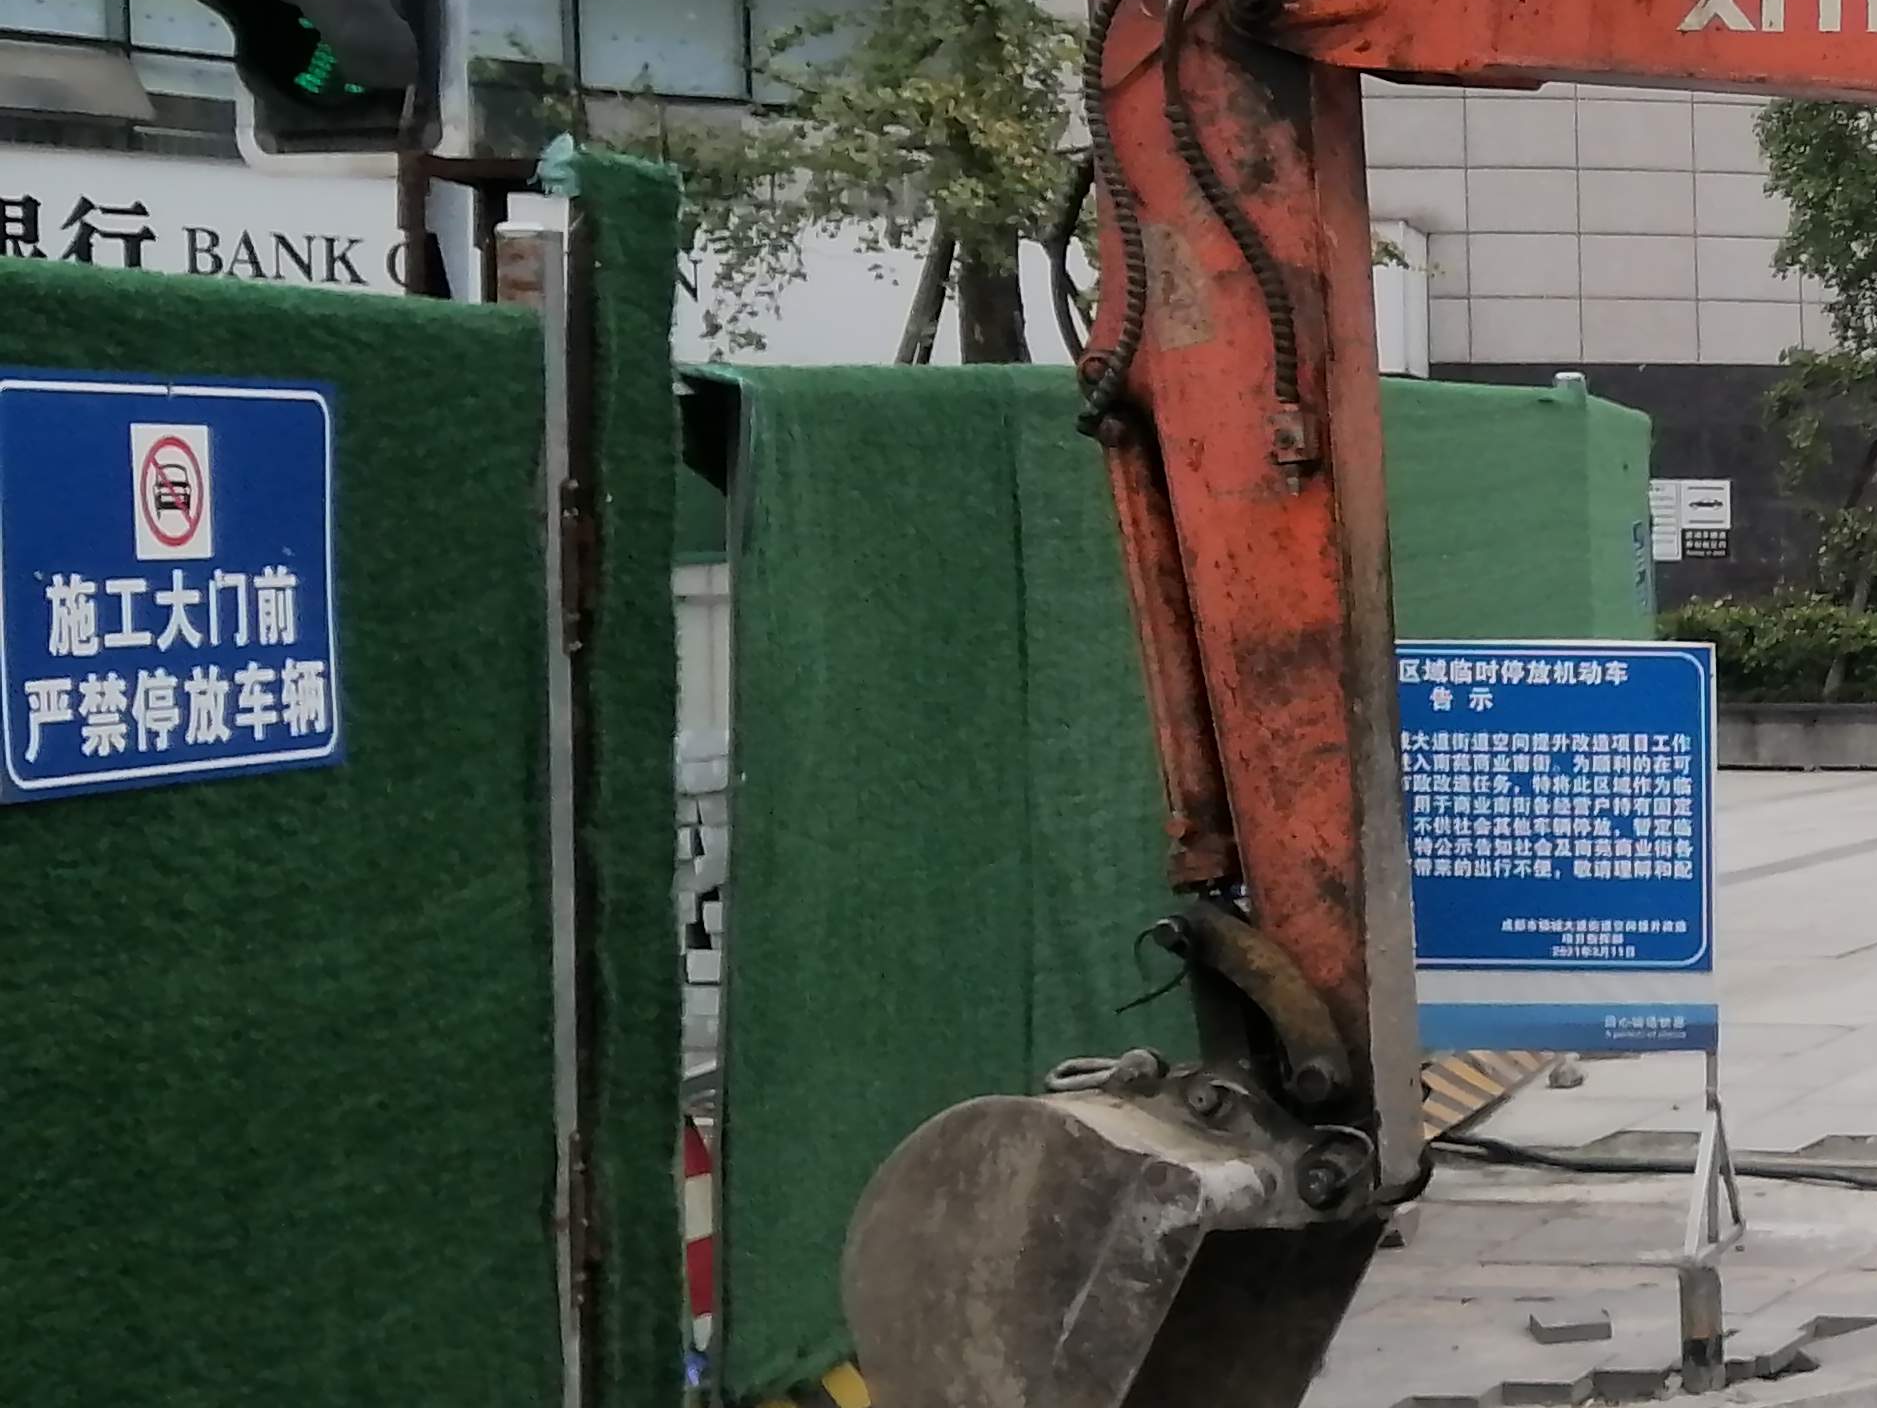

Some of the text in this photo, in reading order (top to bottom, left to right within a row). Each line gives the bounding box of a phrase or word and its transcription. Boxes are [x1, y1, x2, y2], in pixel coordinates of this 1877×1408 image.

[183, 225, 369, 286] BANK
[46, 565, 298, 657] 施工大门前
[24, 657, 328, 764] 严禁停放车辆
